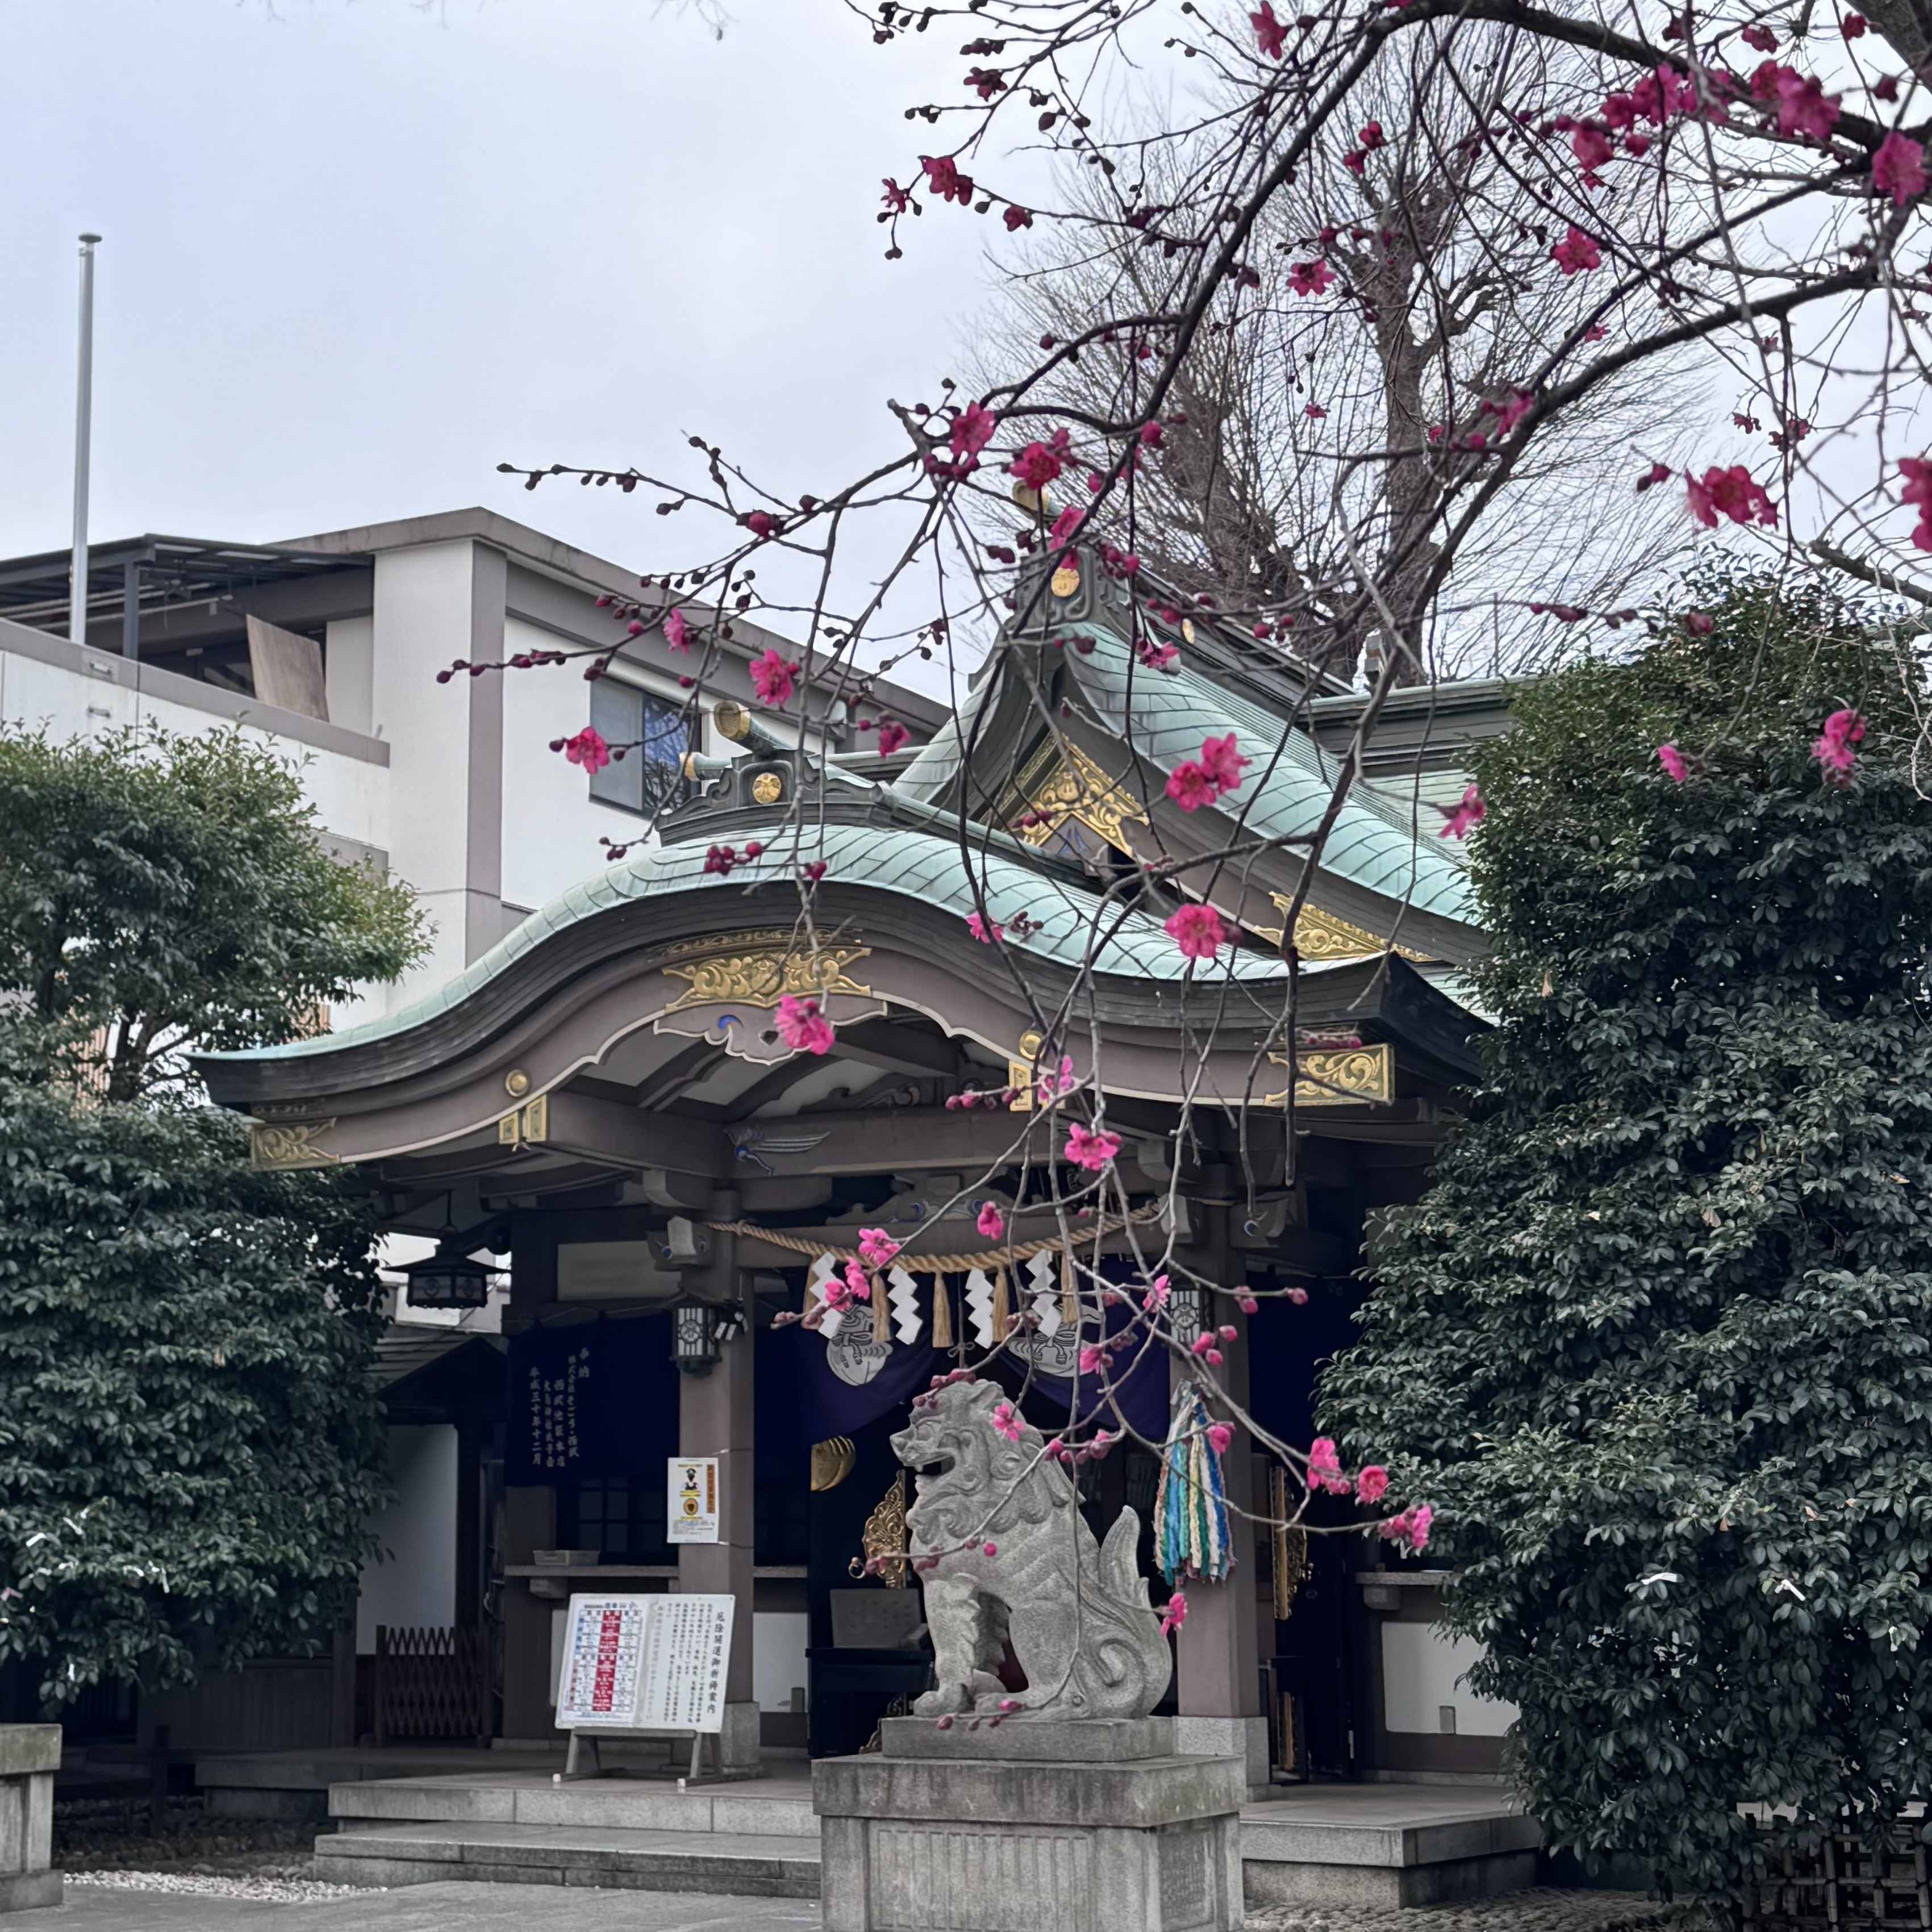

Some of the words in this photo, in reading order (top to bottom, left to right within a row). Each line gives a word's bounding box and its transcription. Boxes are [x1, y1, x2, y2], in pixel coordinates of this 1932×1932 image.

[529, 1367, 541, 1465] 平成三十年十二月
